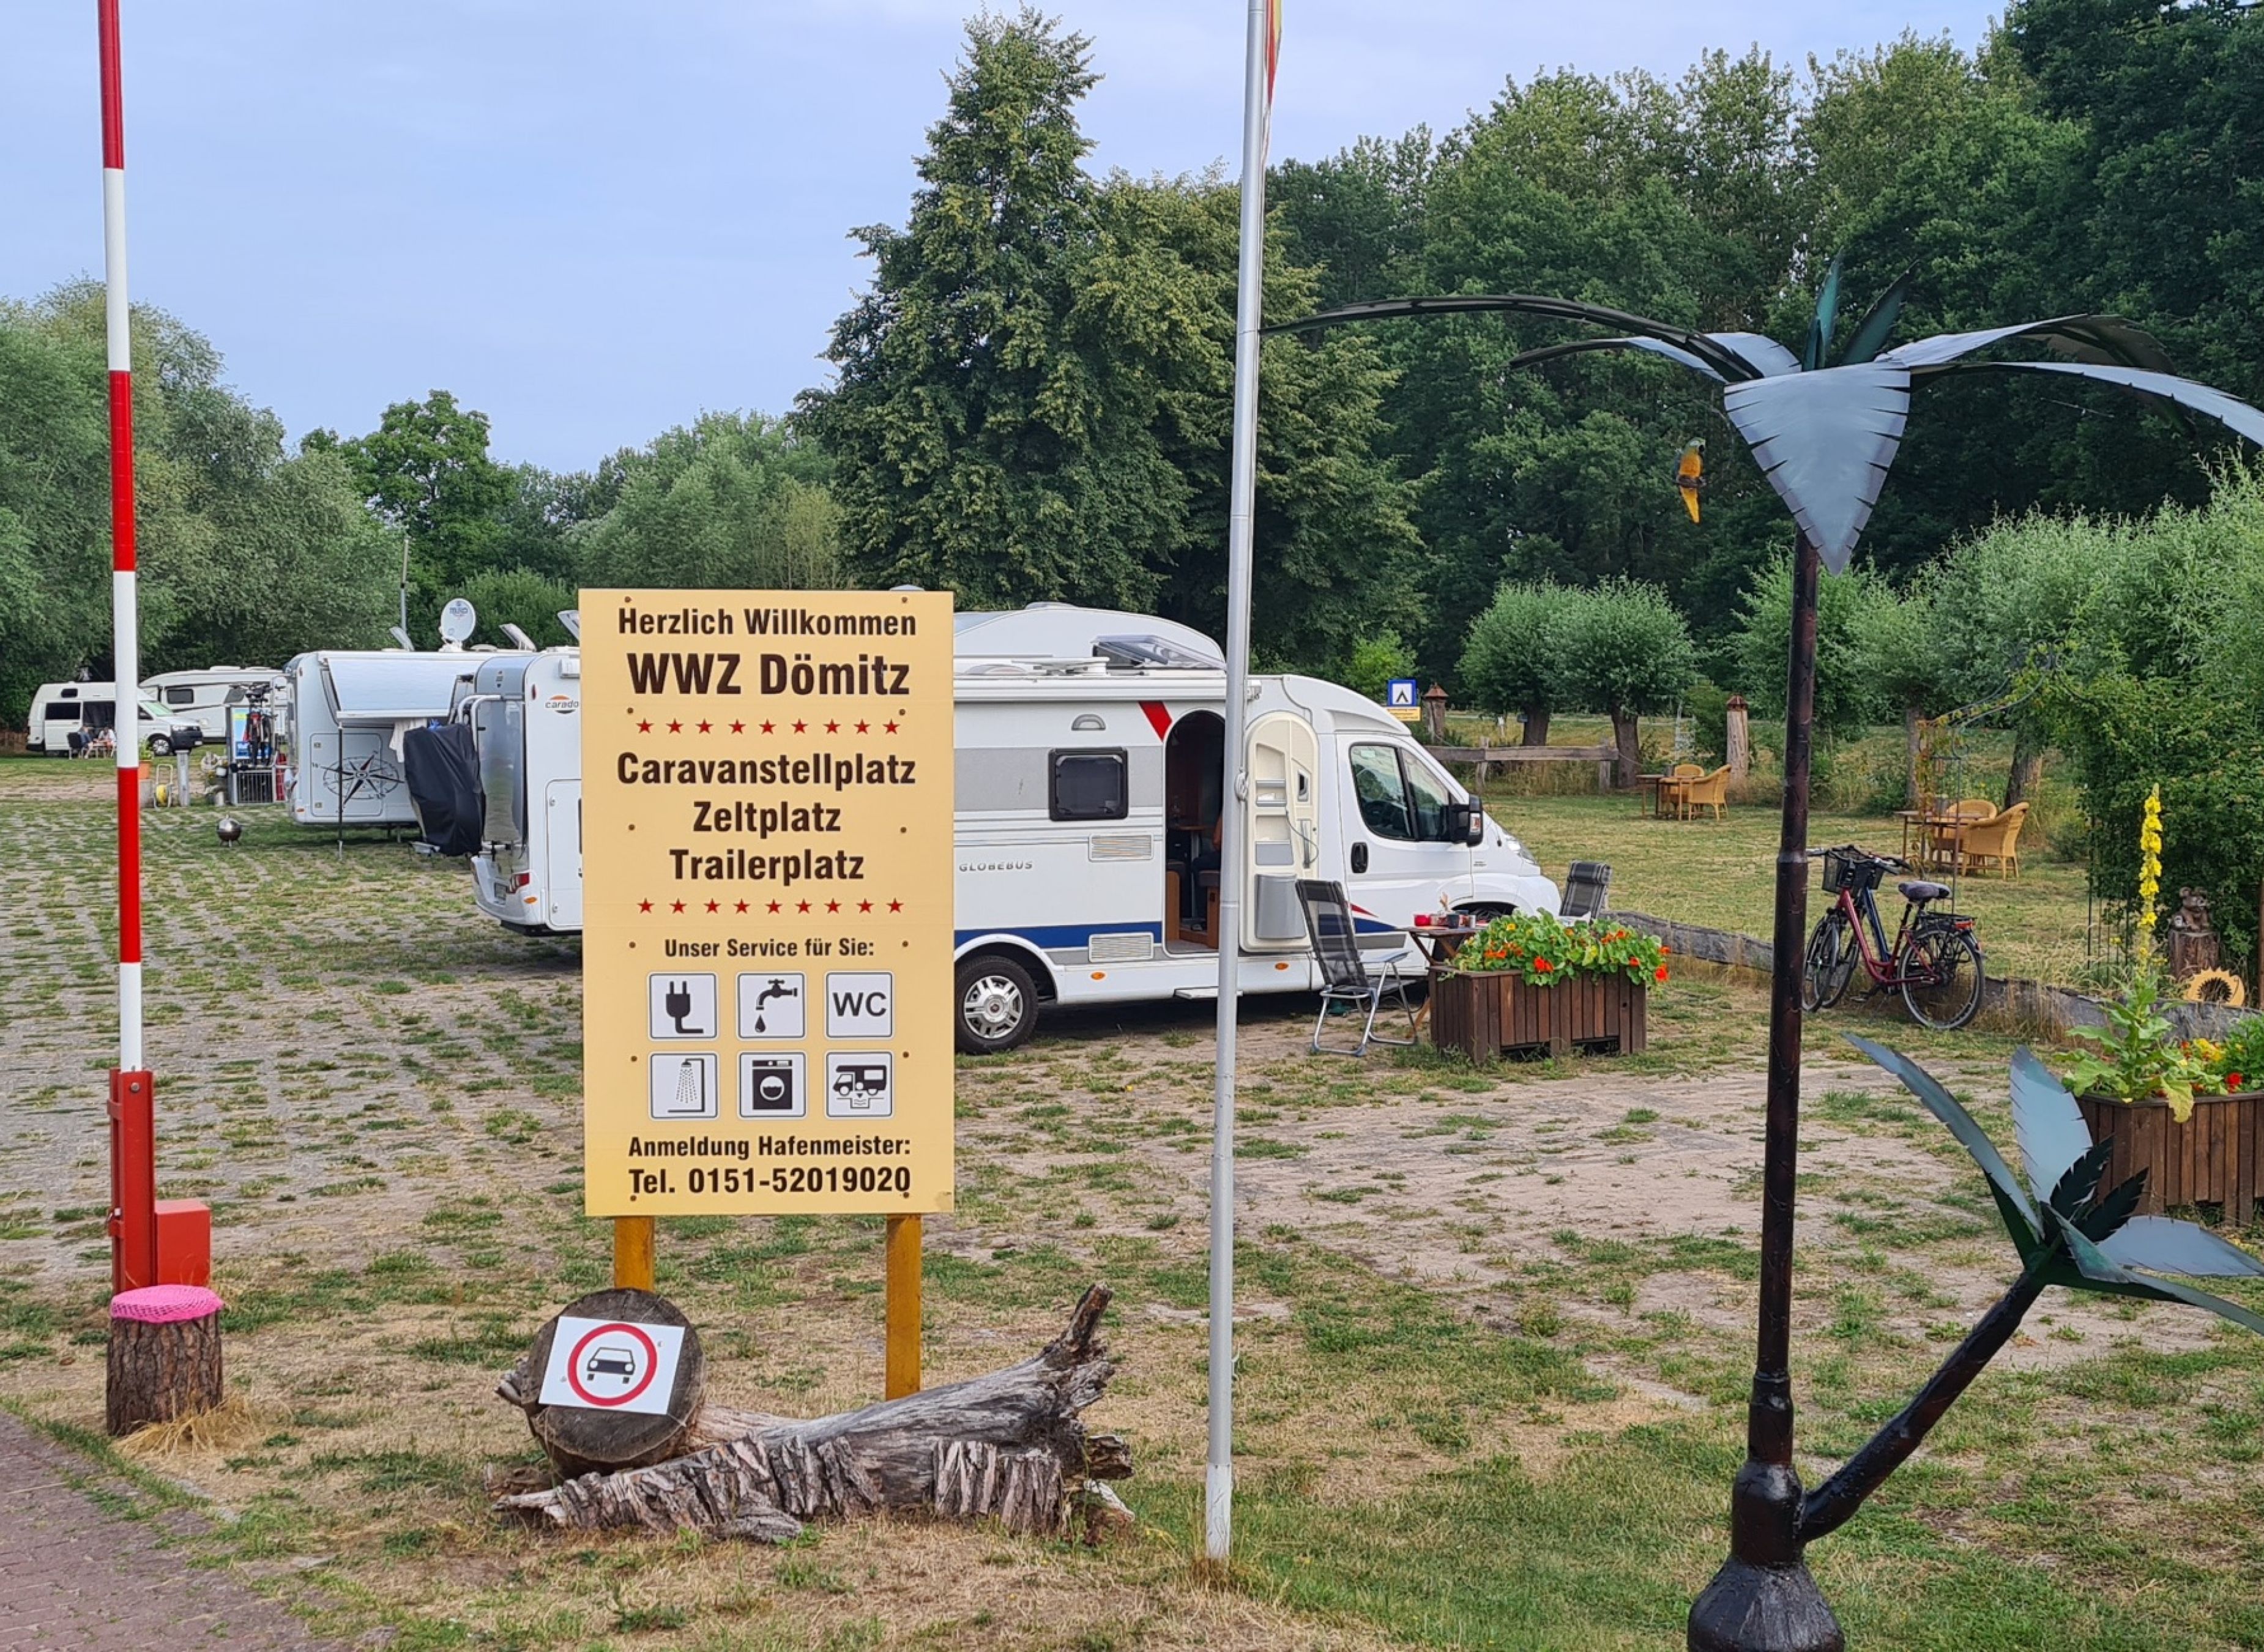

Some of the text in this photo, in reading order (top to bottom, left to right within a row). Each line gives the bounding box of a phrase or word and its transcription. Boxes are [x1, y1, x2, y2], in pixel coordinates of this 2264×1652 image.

[619, 608, 916, 636] Herzlich Willkommen
[626, 653, 909, 696] WWZ Dömitz
[617, 752, 915, 791] Caravanstellplatz
[693, 801, 841, 839] Zeltplatz
[669, 849, 864, 887] Trailerplatz
[958, 860, 1033, 872] GLOBEBUS
[665, 937, 874, 958] Unser Service für Sie:
[832, 992, 887, 1017] WC
[628, 1134, 910, 1161] Anmeldung Hafenmeister:
[628, 1166, 910, 1193] Tel. 0151-52019020
